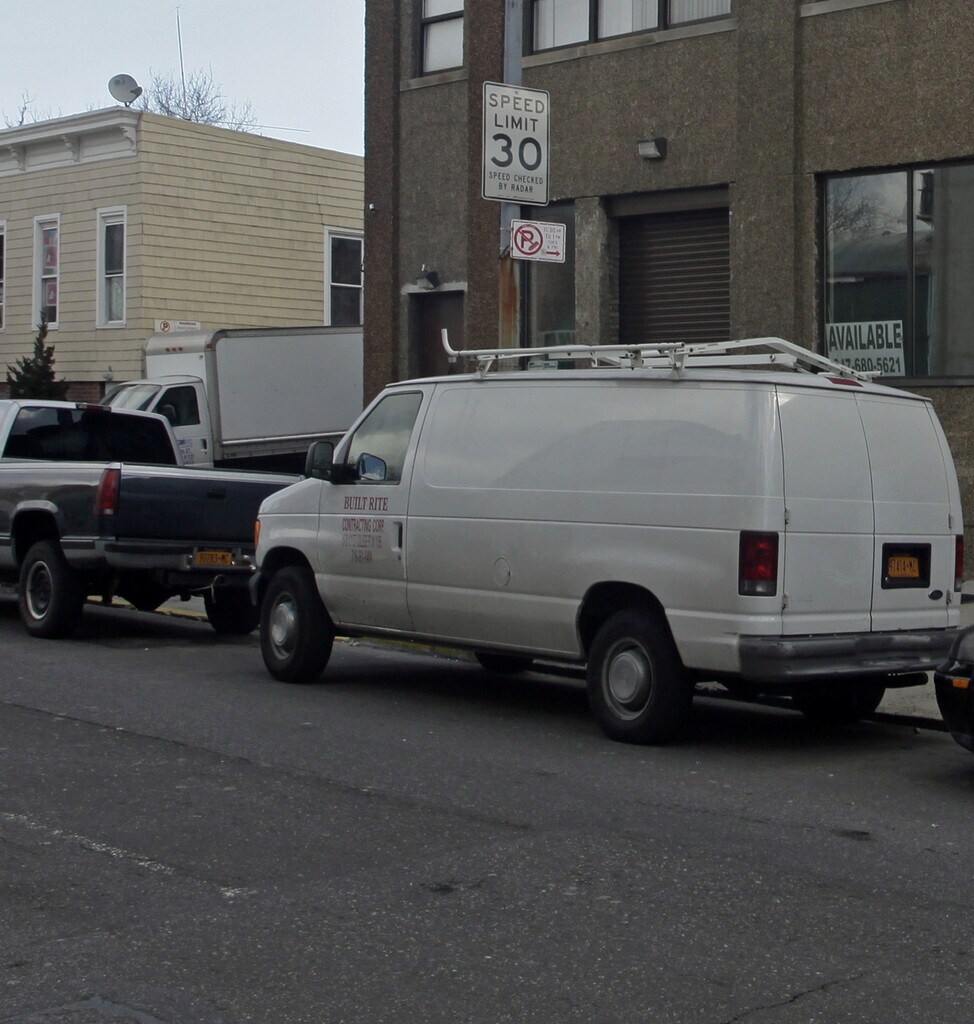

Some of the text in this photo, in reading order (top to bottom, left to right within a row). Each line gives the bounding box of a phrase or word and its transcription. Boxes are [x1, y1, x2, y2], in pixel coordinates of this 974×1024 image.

[488, 93, 545, 114] SPEED
[494, 113, 539, 132] LIMIT
[490, 133, 542, 171] 30
[488, 171, 543, 185] SPEED CHECKED
[498, 182, 534, 193] BY RADAR
[829, 323, 902, 351] AVAILABLE
[343, 496, 389, 511] BUILT RITE
[342, 518, 371, 532] CONTRACTING
